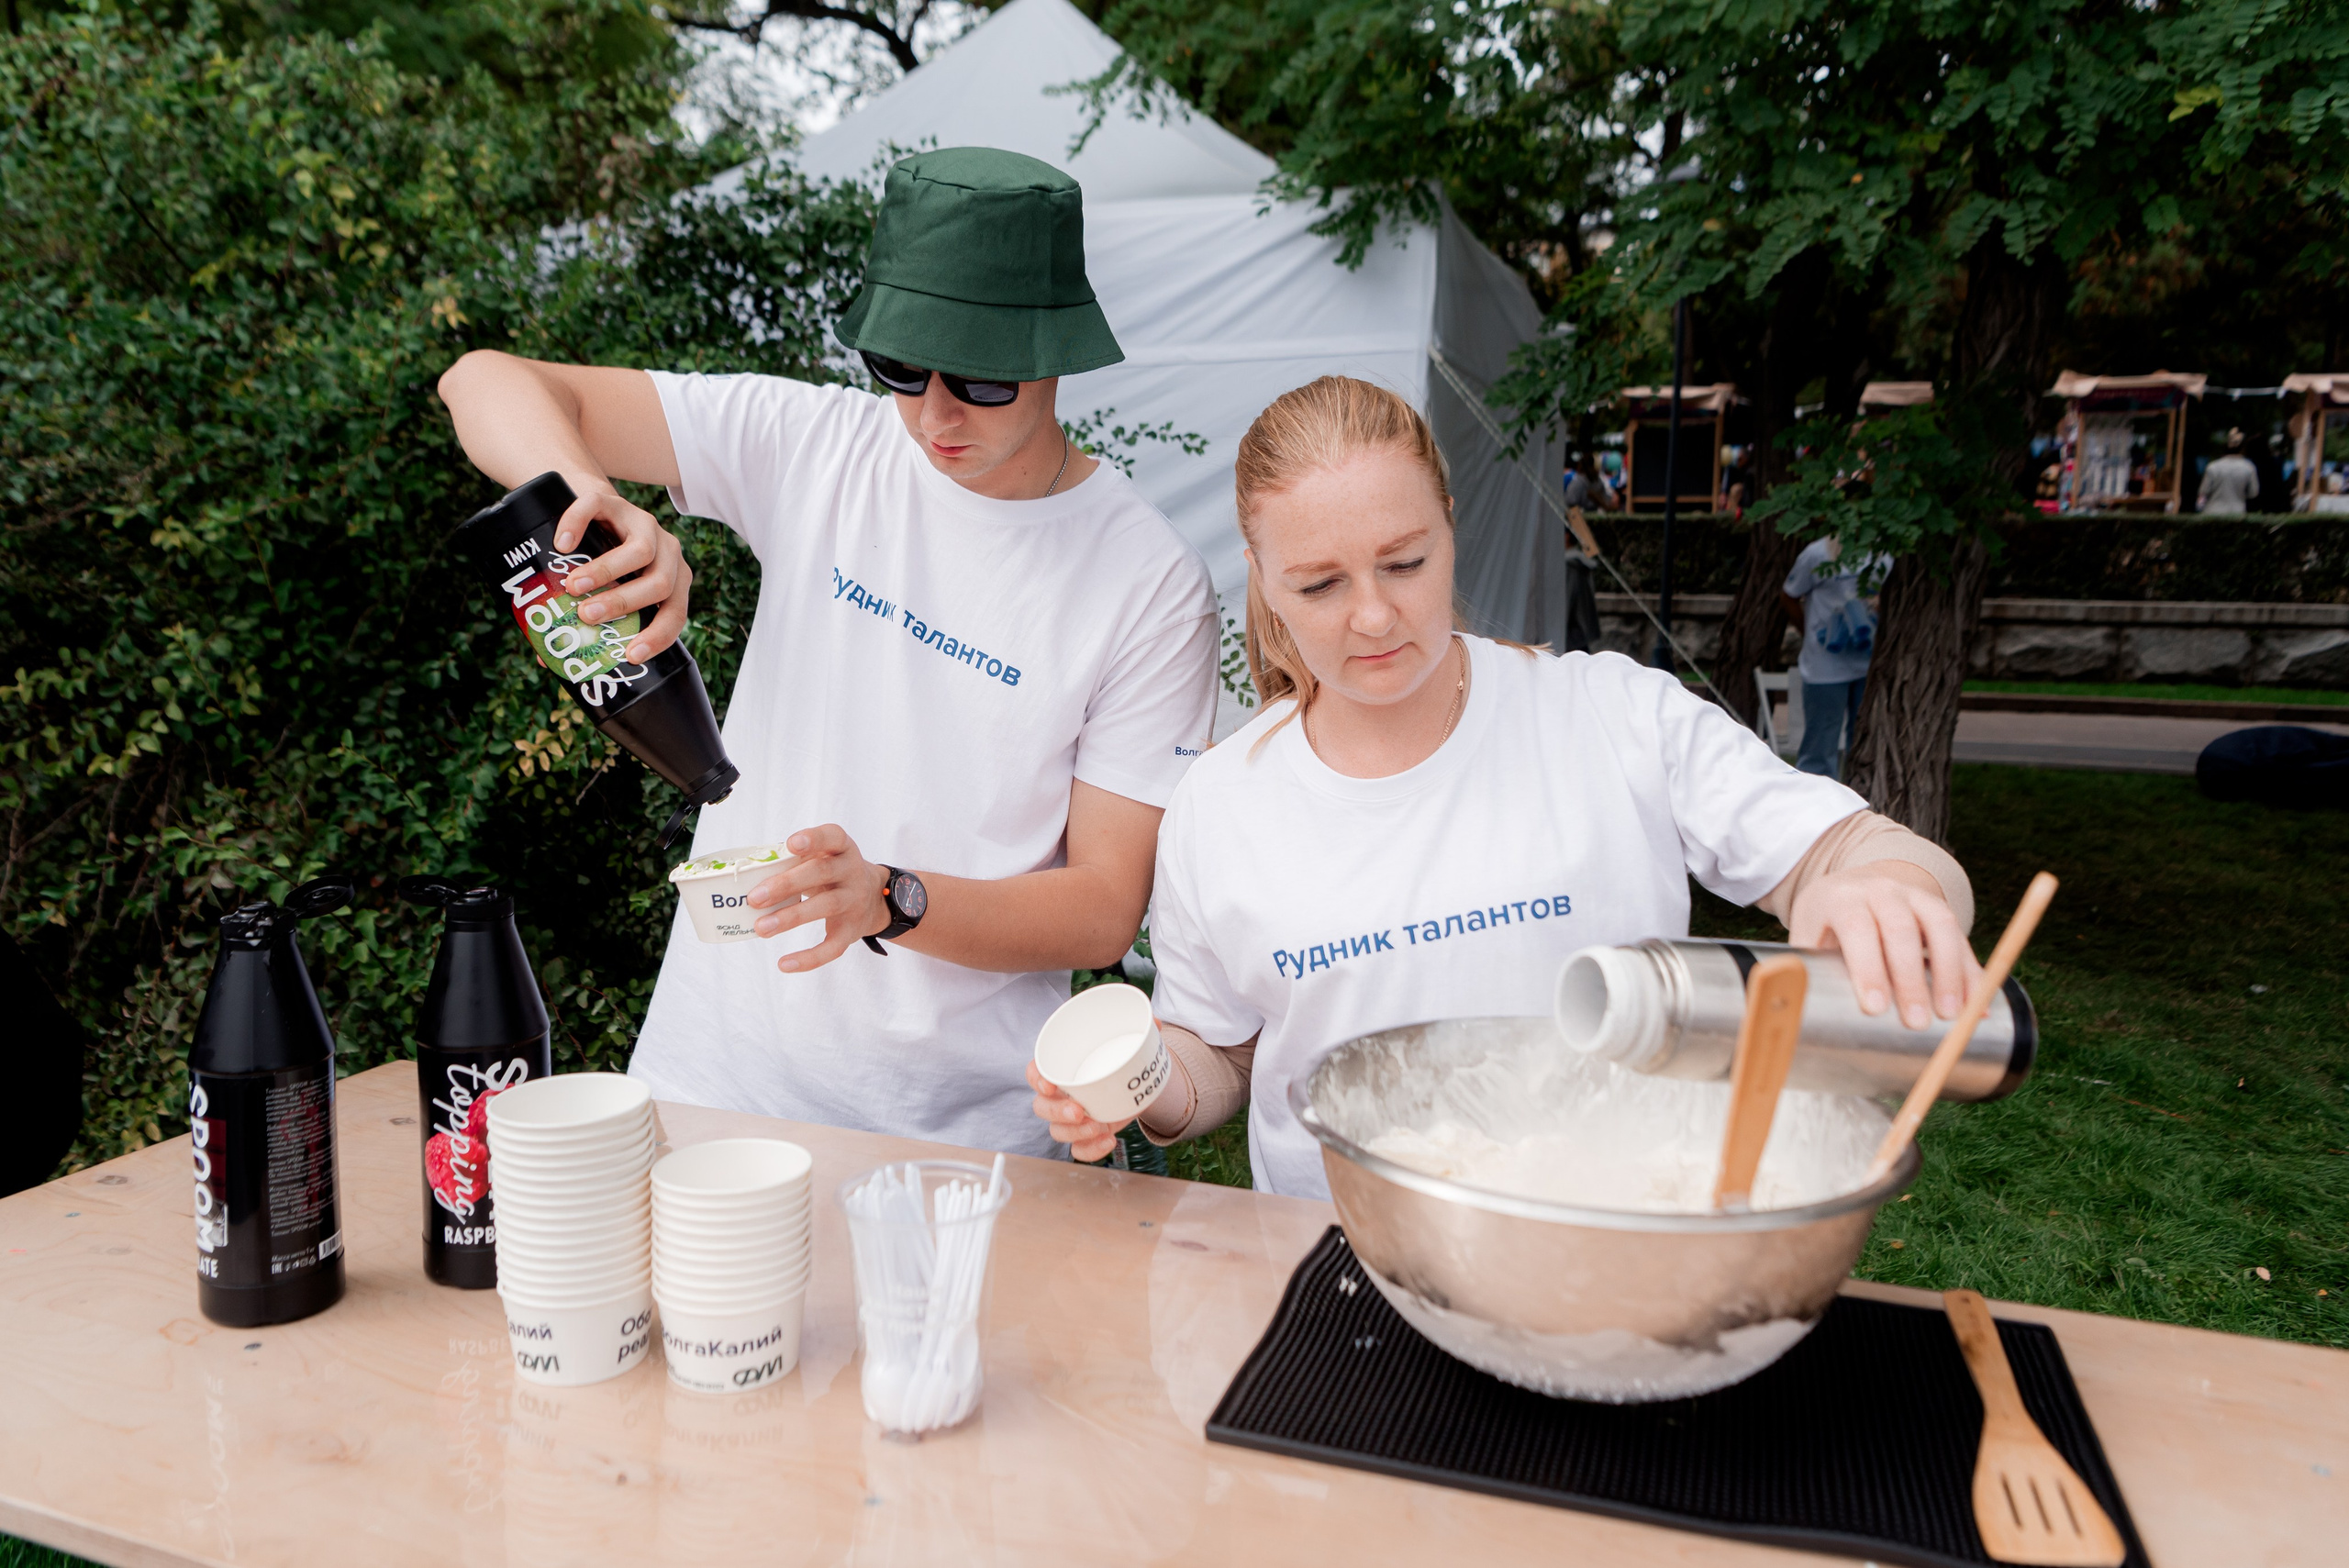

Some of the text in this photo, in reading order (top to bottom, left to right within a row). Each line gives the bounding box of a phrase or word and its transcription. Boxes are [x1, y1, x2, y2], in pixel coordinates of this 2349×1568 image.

[503, 538, 541, 569] KIWI
[501, 566, 618, 706] SPOOM
[903, 609, 1022, 687] талантов
[1273, 895, 1572, 980] Рудник талантов
[445, 1225, 496, 1245] RASPB
